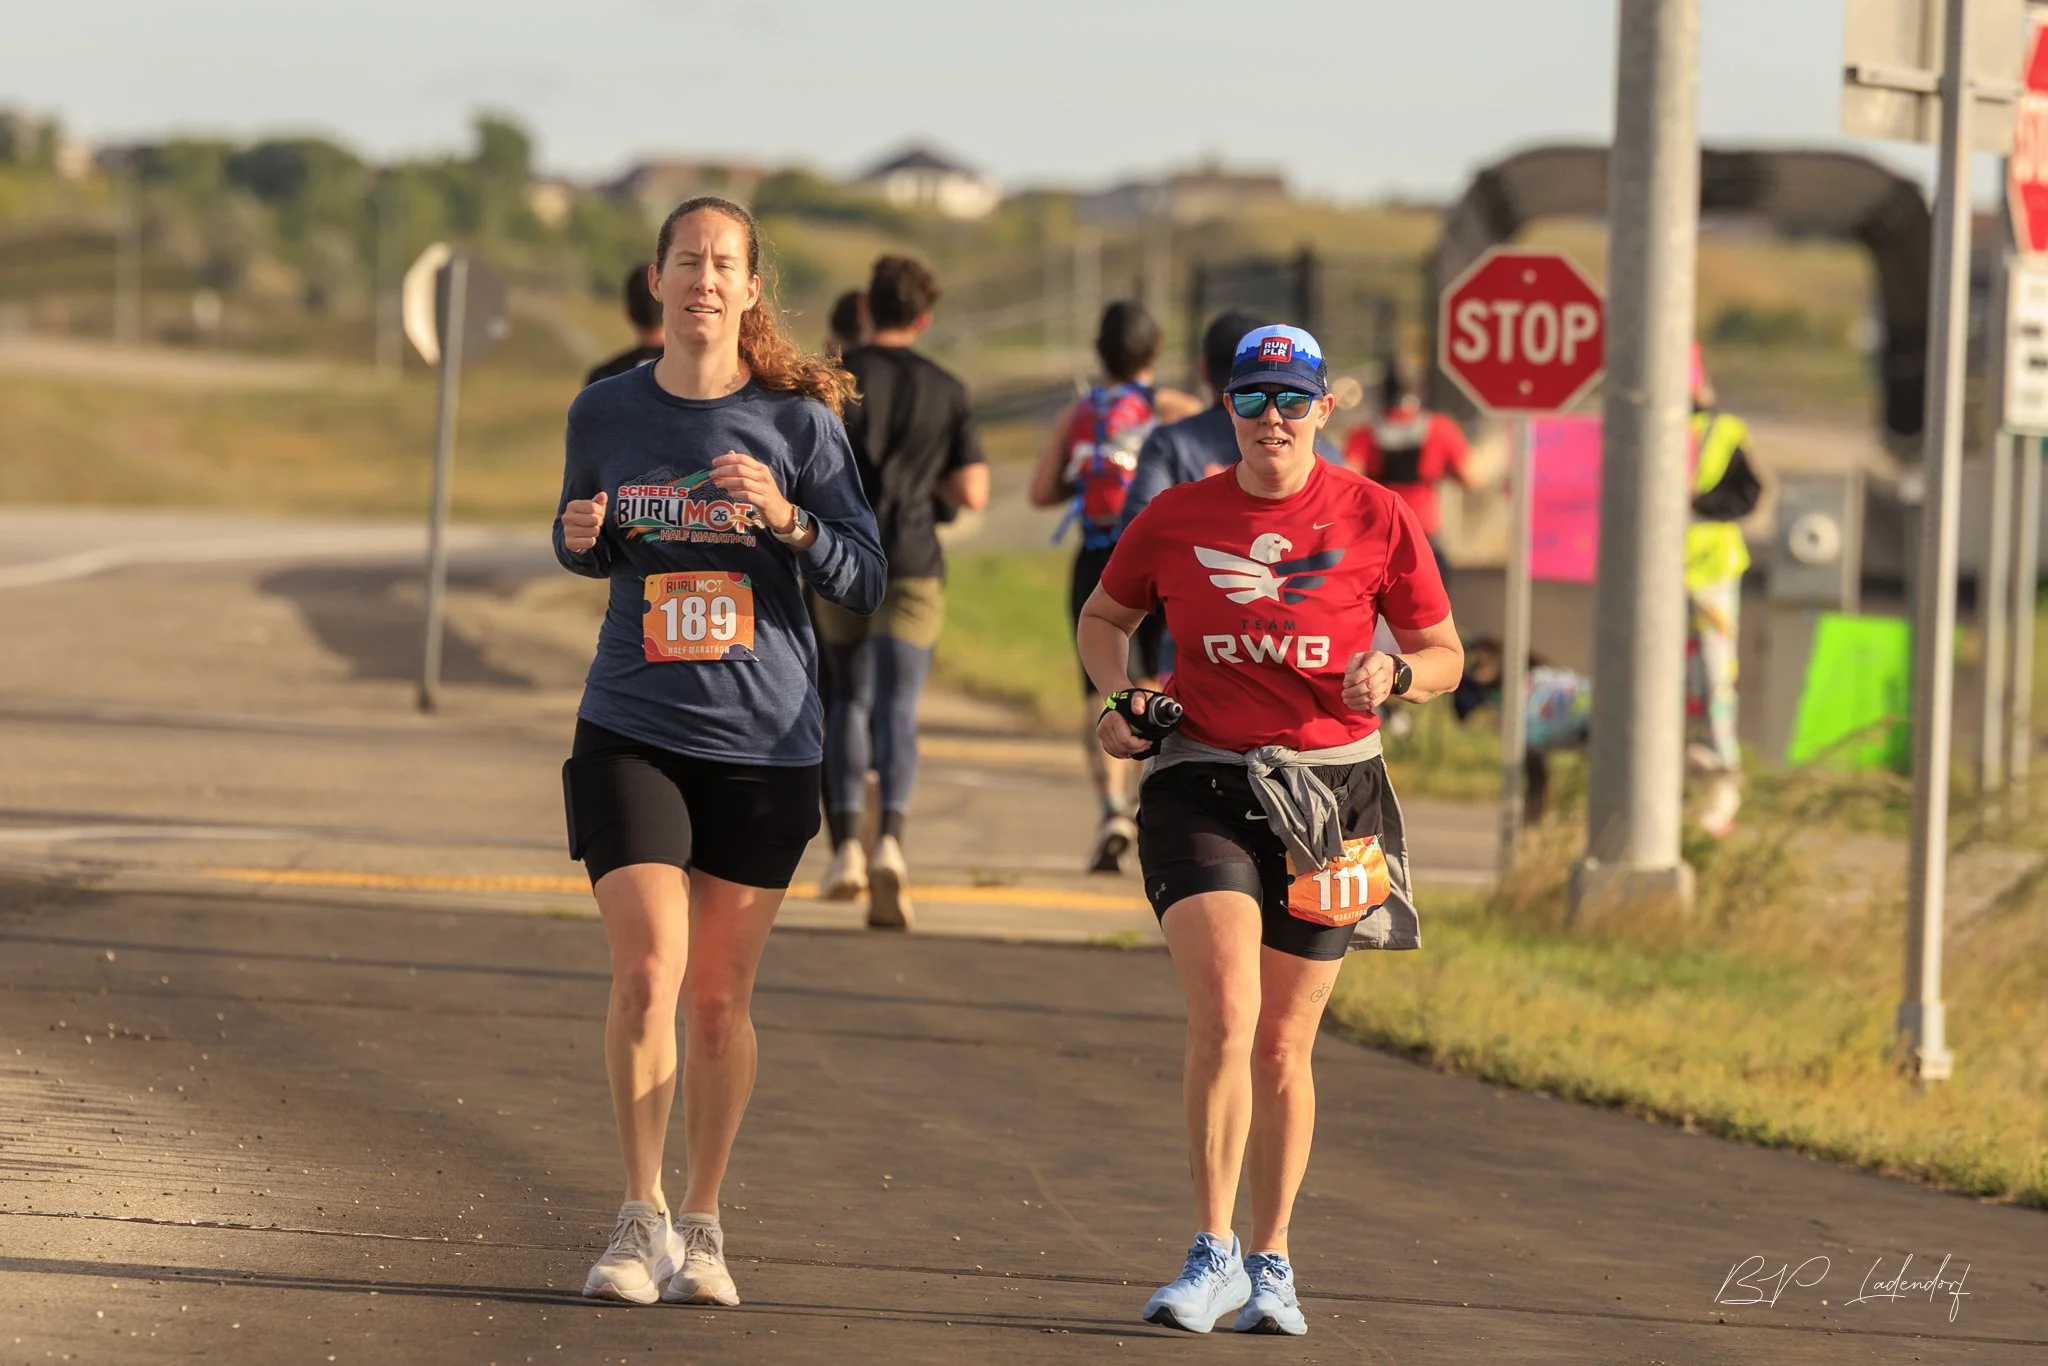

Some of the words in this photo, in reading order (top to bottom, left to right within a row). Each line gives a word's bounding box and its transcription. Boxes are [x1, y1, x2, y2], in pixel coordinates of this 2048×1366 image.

[1454, 299, 1598, 365] STOP
[1264, 341, 1288, 350] RUN
[1263, 348, 1286, 357] PLR
[618, 486, 688, 498] SCHEELS
[713, 509, 728, 522] 26
[661, 529, 690, 541] HALF
[691, 531, 757, 547] MARATHON
[659, 596, 737, 641] 189
[1240, 618, 1296, 631] TEAM
[668, 645, 687, 655] HALF
[688, 645, 730, 654] MARATHON
[1202, 634, 1330, 668] RWB
[1312, 863, 1368, 911] 111
